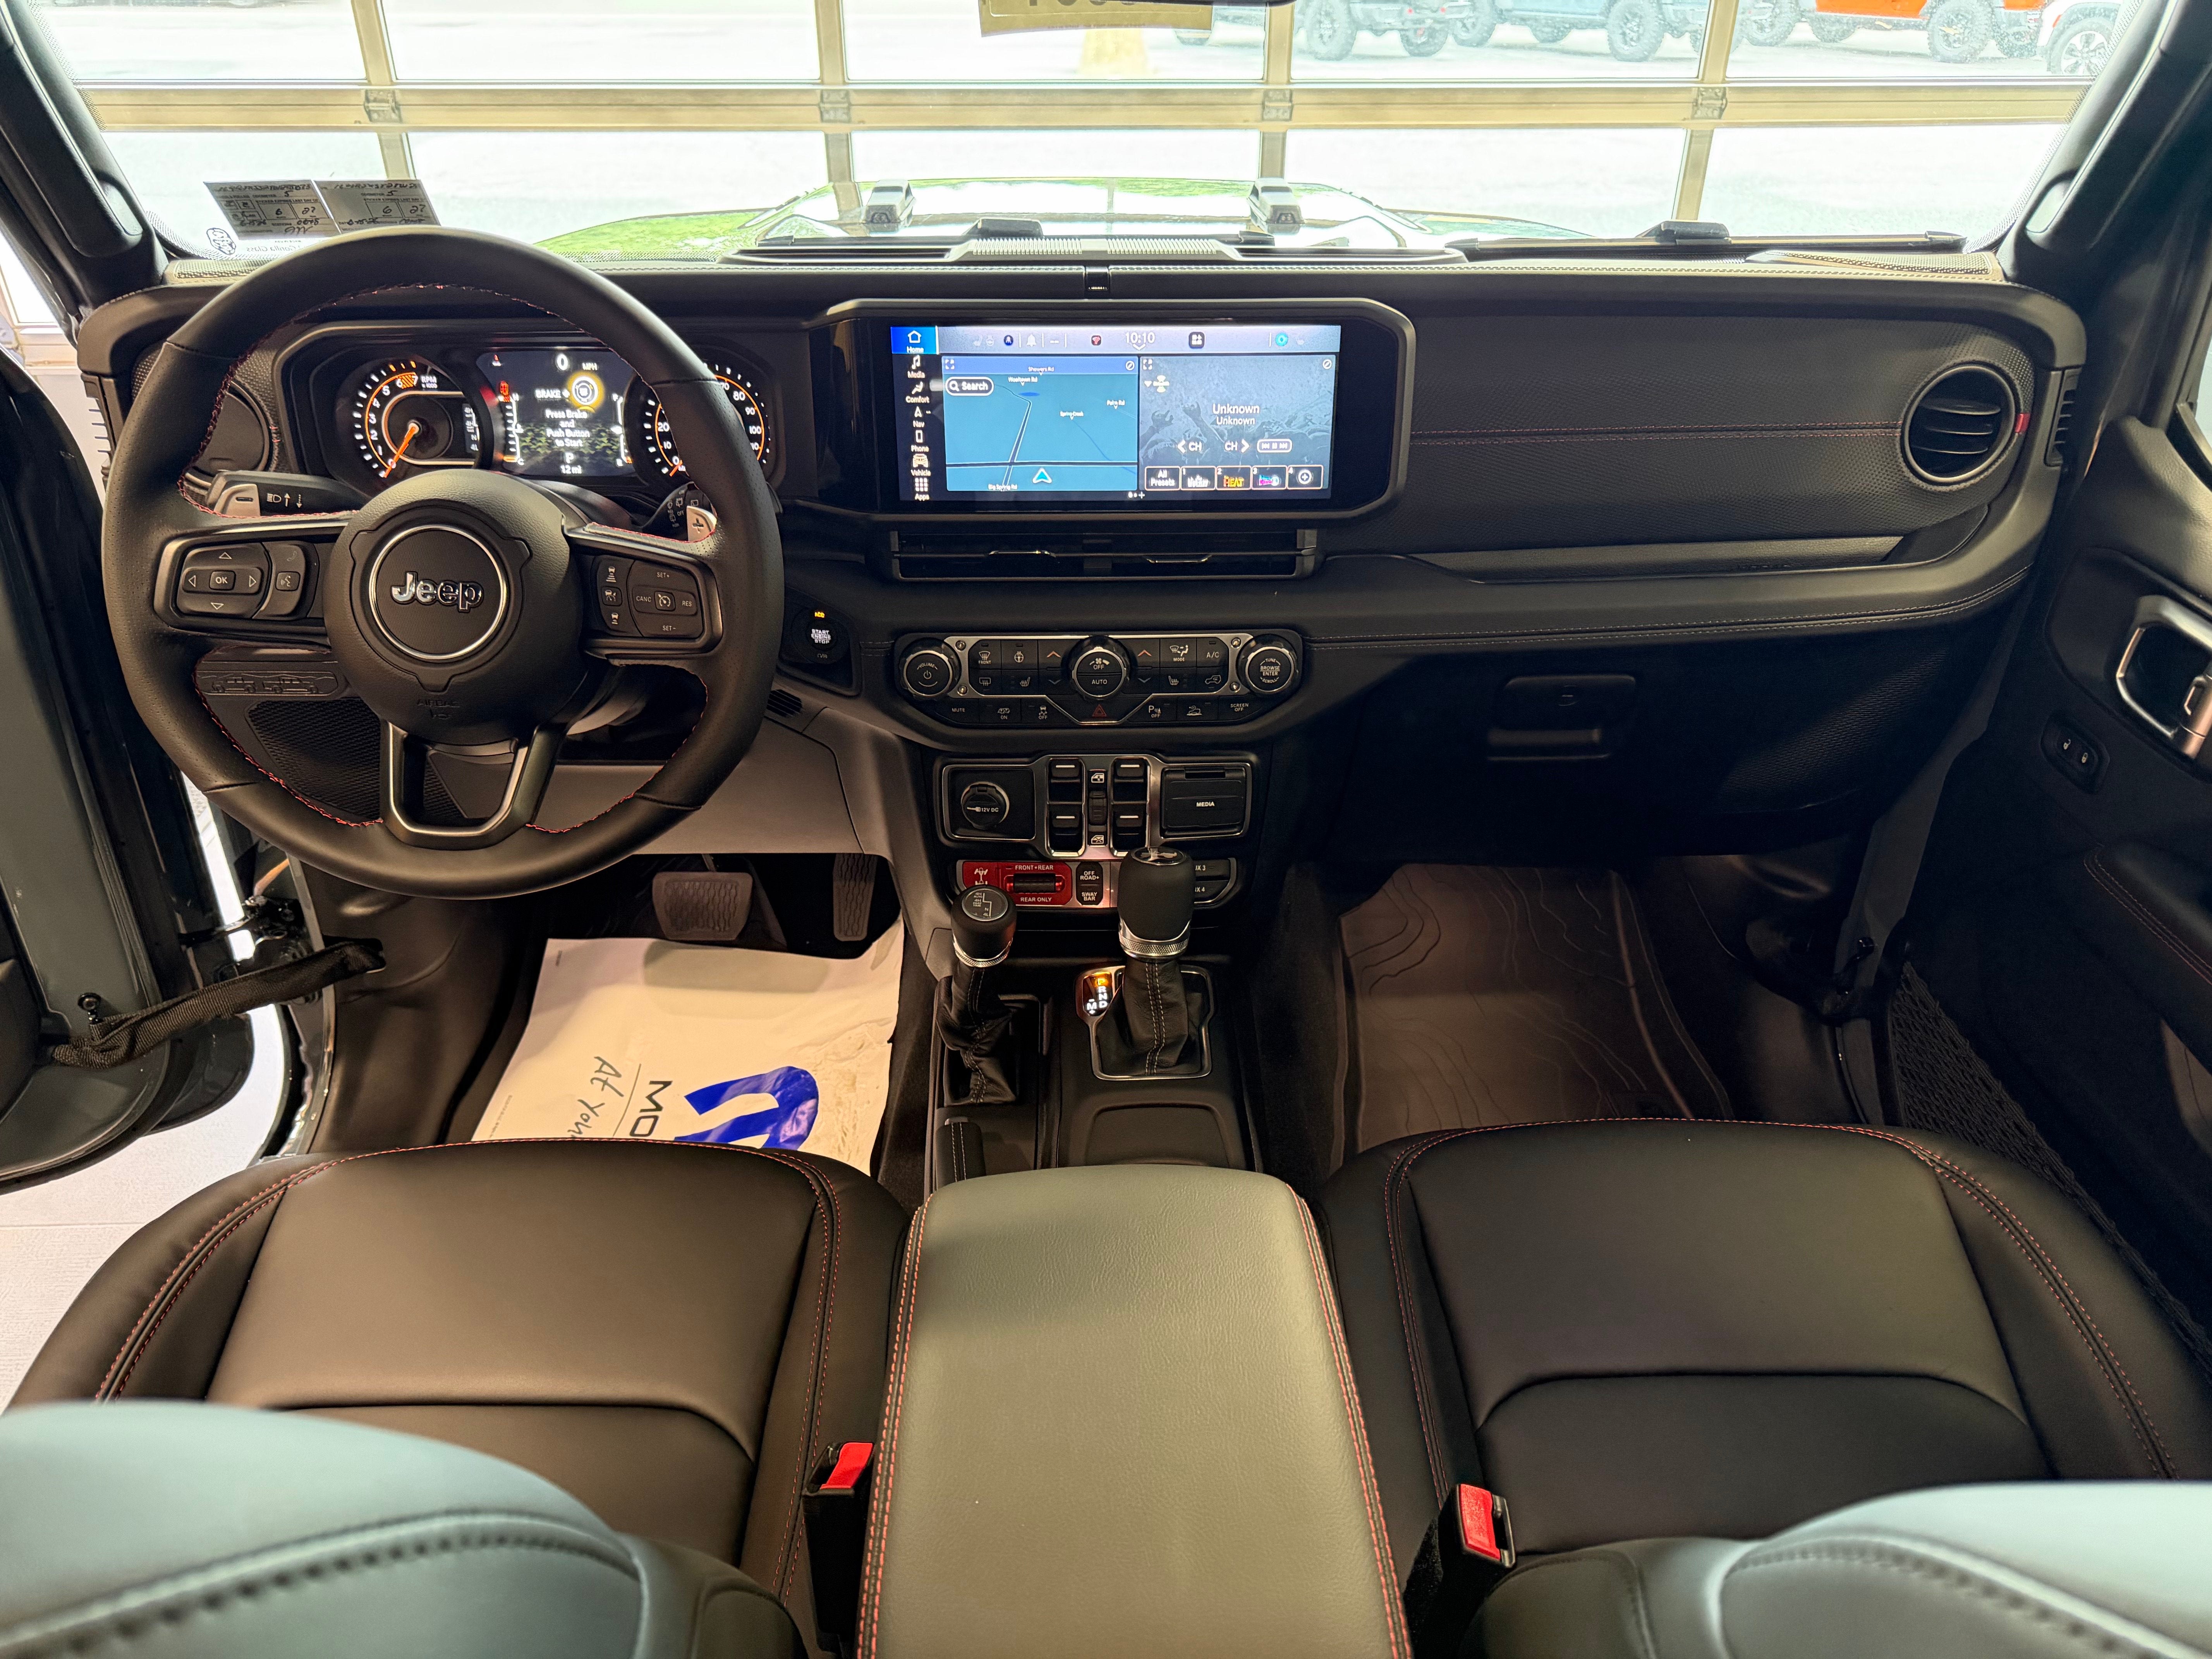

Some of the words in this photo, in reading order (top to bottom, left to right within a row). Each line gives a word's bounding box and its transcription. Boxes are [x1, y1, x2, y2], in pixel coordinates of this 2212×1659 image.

[383, 206, 392, 214] 6
[1125, 332, 1155, 343] 10:10
[556, 353, 569, 371] 0
[396, 378, 403, 388] 6
[413, 375, 419, 386] 7
[962, 381, 988, 390] Search
[382, 386, 390, 396] 5
[535, 389, 561, 399] BRAKE
[733, 391, 746, 401] 80
[372, 398, 381, 409] 4
[1212, 403, 1260, 414] Unknown
[545, 409, 566, 418] Press
[566, 409, 588, 418] Brake
[745, 407, 755, 415] 90
[369, 414, 376, 424] 3
[559, 419, 575, 428] and
[1216, 416, 1255, 425] Unknown
[658, 422, 670, 431] 20
[749, 426, 762, 434] 100
[370, 430, 378, 441] 2
[546, 428, 565, 437] Push
[565, 429, 591, 438] Button
[564, 438, 583, 447] Start
[1188, 441, 1202, 452] CH
[1224, 441, 1238, 451] CH
[377, 445, 383, 456] 1
[565, 452, 574, 464] P
[672, 456, 680, 465] 0
[560, 465, 571, 474] 12
[1158, 469, 1167, 478] All
[1151, 478, 1175, 487] Presets
[391, 571, 484, 611] Jeep
[590, 1056, 625, 1097] At
[567, 1099, 606, 1139] You
